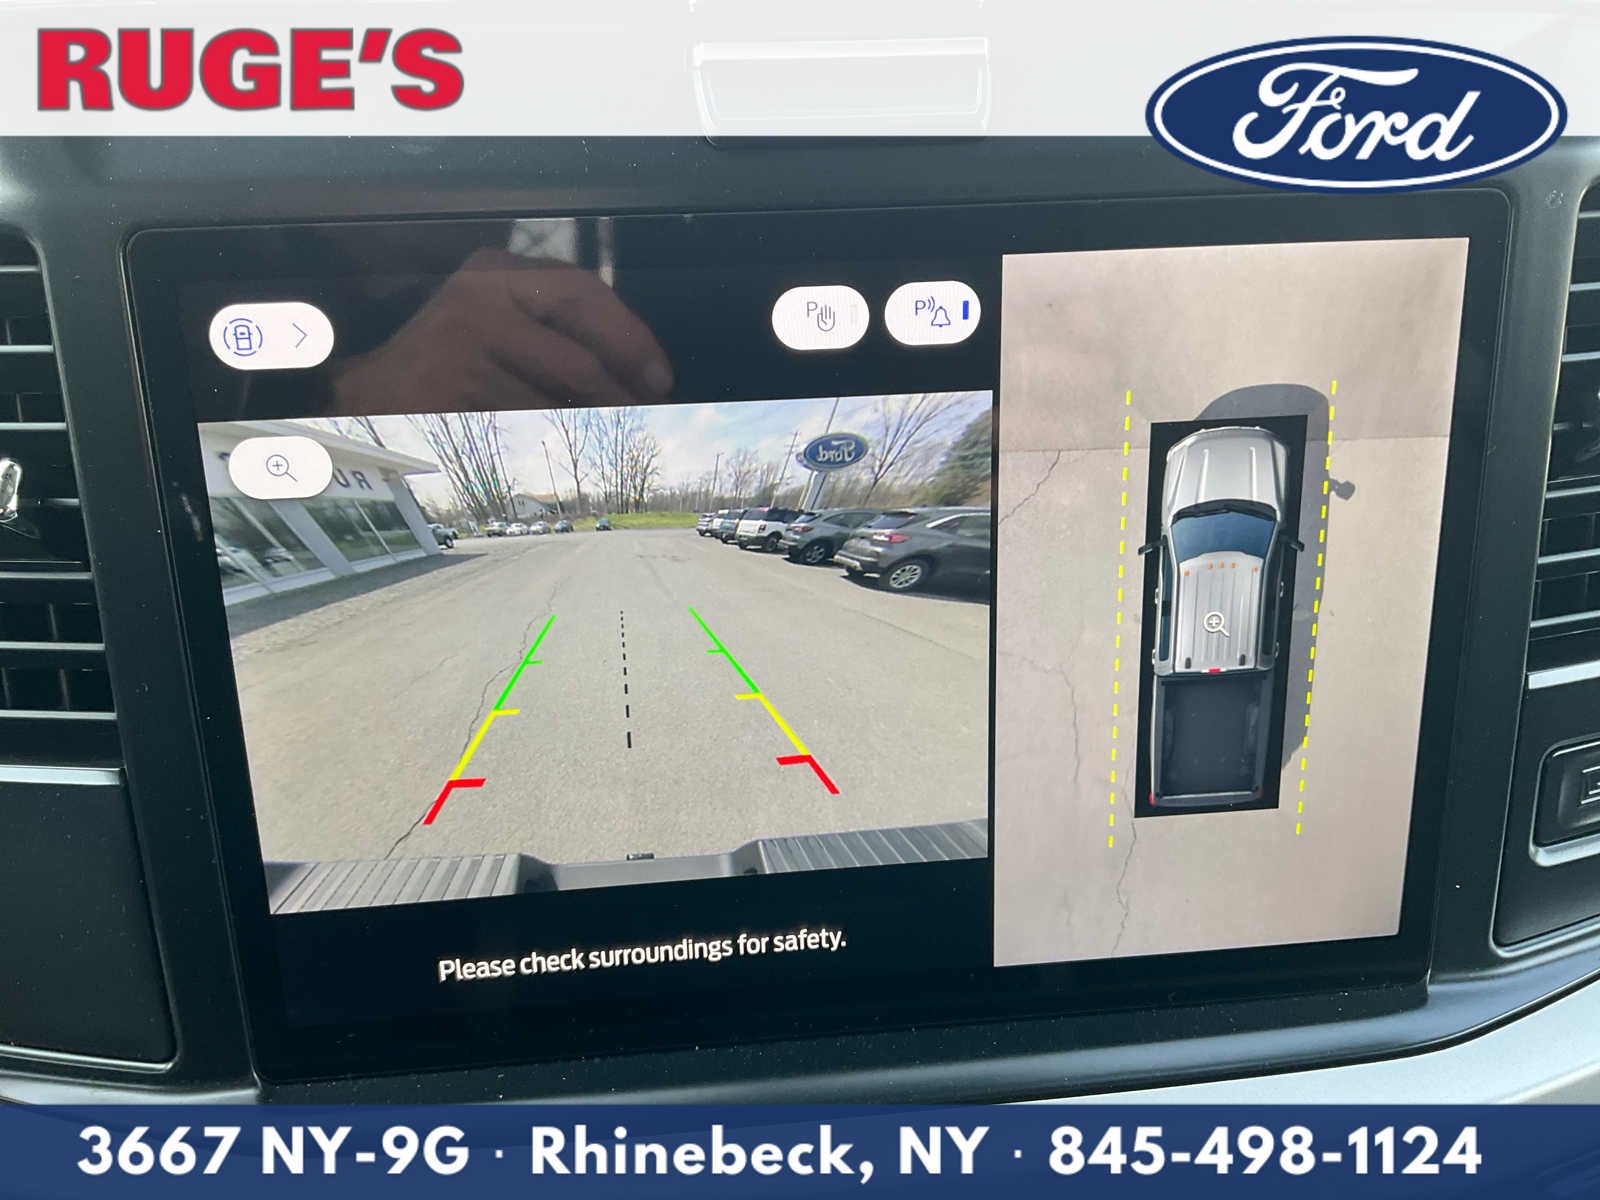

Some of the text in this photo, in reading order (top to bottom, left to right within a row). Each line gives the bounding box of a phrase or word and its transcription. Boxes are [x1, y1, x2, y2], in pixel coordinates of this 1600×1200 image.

[438, 927, 847, 983] Please check surroundings for safety.
